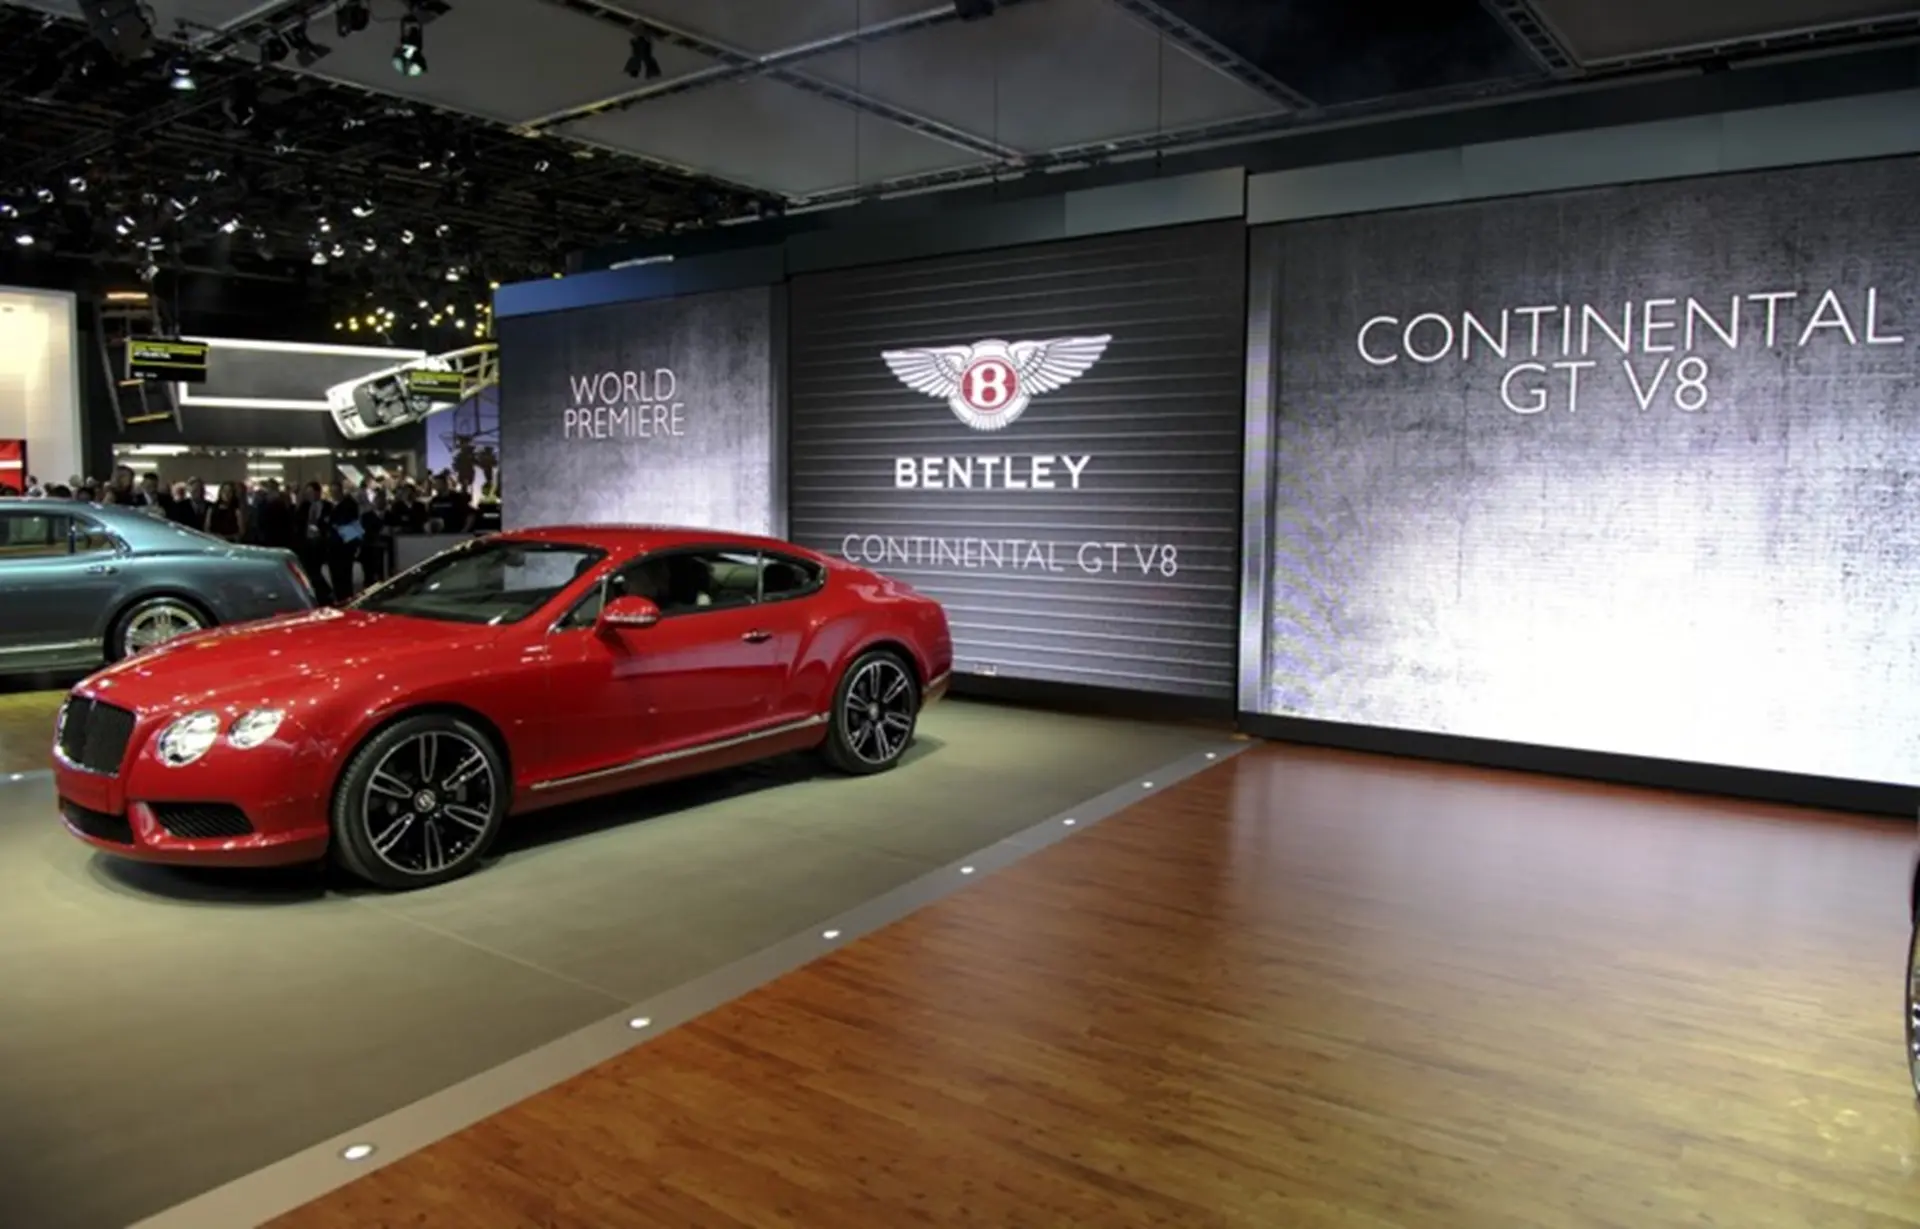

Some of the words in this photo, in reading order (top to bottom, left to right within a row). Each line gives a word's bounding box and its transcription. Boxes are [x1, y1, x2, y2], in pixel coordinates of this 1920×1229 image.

[1357, 286, 1905, 365] CONTINENTAL
[569, 367, 677, 405] WORLD
[970, 362, 1008, 408] B
[1501, 361, 1596, 414] GT
[1623, 356, 1709, 411] V8
[563, 402, 685, 439] PREMIERE
[894, 454, 1091, 490] BENTLEY
[842, 533, 1065, 573] CONTINENTAL
[1077, 541, 1127, 574] GT
[1134, 543, 1178, 578] V8
